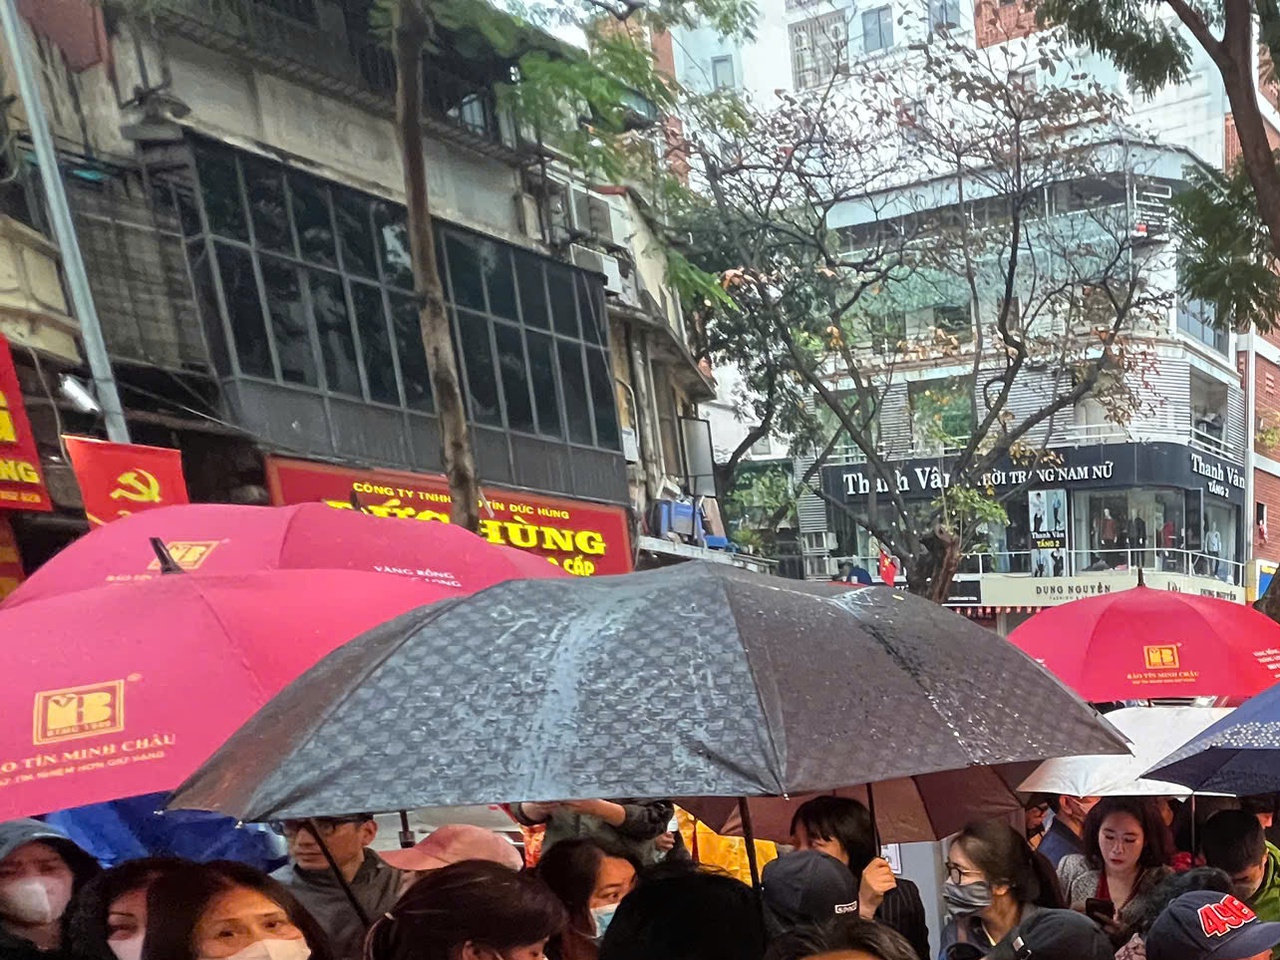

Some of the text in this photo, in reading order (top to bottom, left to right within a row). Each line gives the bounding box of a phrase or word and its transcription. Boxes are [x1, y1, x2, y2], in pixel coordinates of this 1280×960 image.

[977, 467, 1006, 487] HỜI
[1009, 468, 1055, 484] TRNG
[1058, 466, 1090, 481] NAM
[1092, 460, 1114, 479] NỮ
[1191, 453, 1246, 489] Thanh Vân
[352, 481, 570, 520] CÔNG TY TNHH TÍN ĐỨC HÙNG
[563, 554, 596, 577] CẤP
[20, 753, 58, 770] TÍN
[63, 742, 117, 762] MINH
[121, 733, 177, 752] CHÂU
